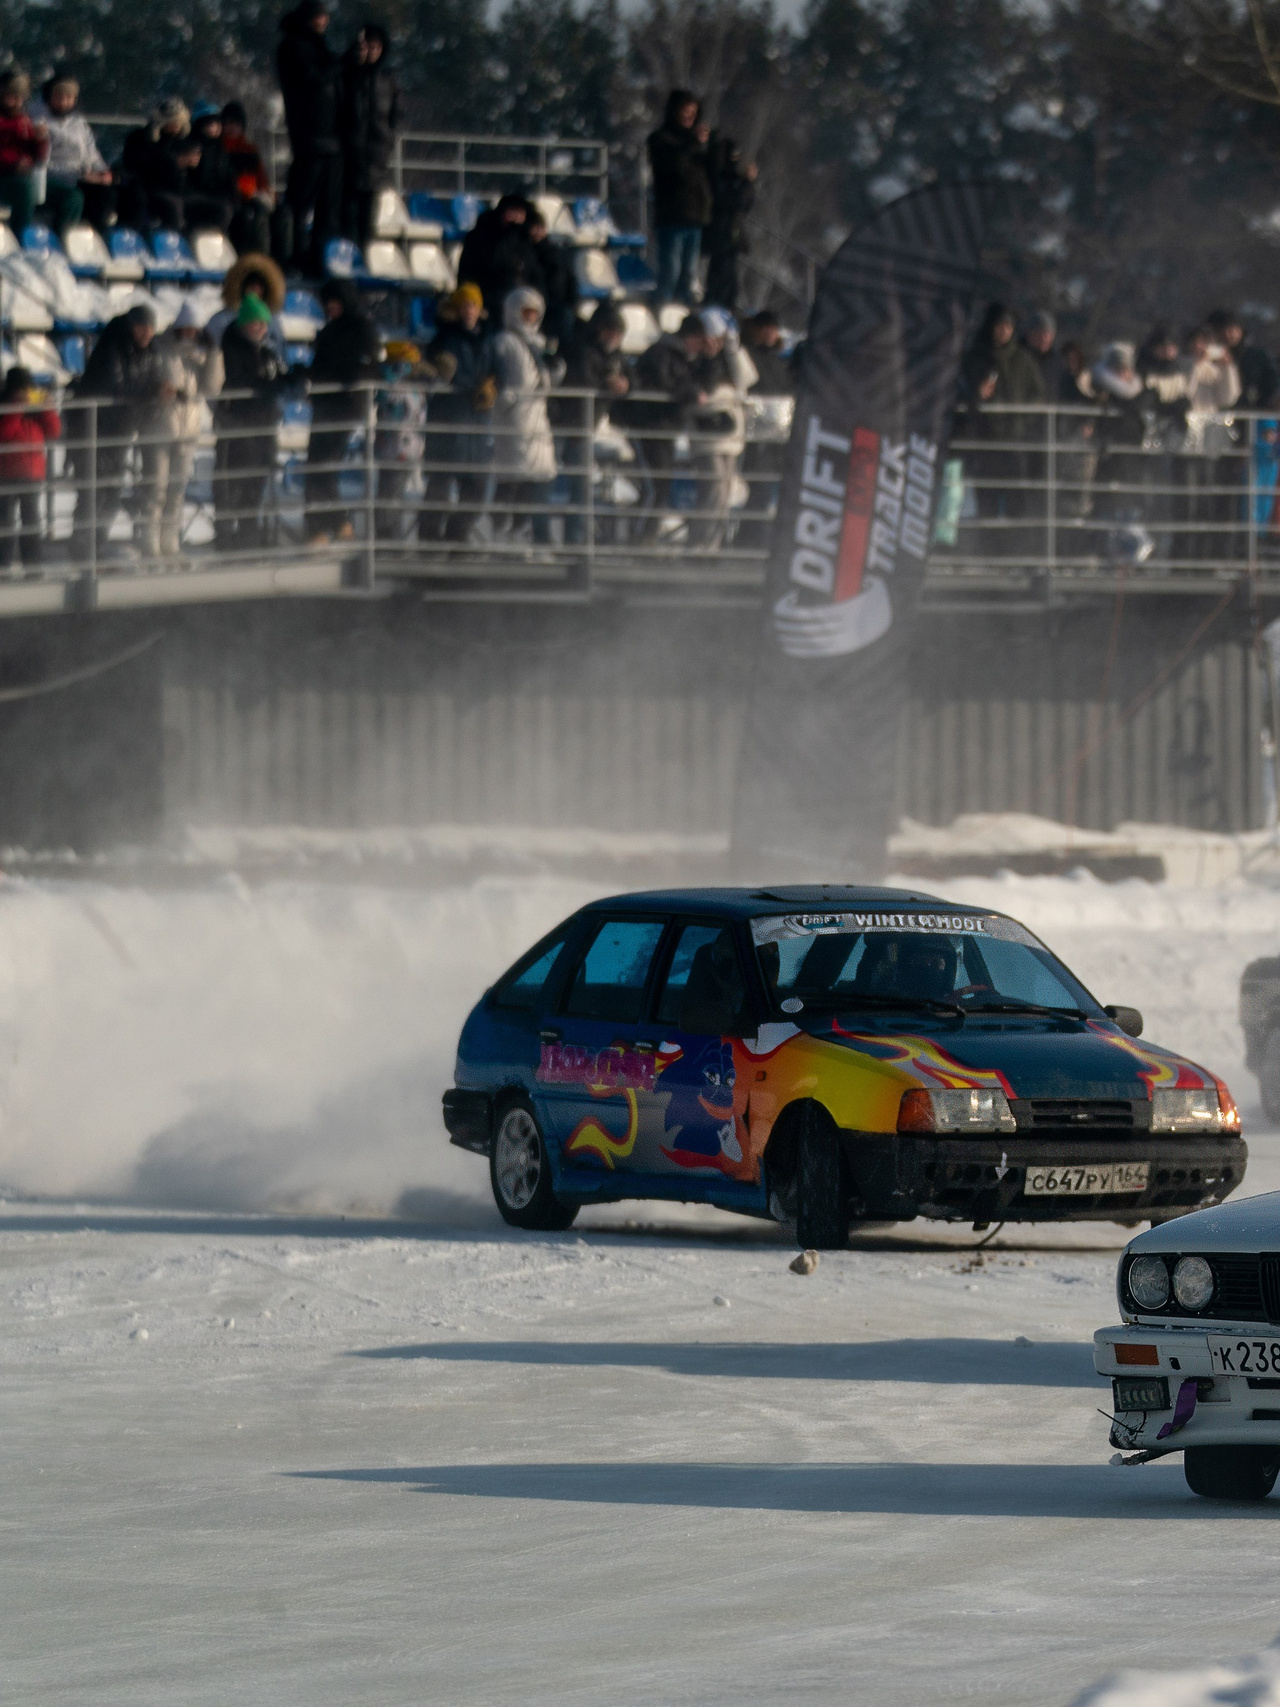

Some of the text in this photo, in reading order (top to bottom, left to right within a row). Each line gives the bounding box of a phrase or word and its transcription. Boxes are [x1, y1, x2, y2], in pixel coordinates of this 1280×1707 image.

[790, 415, 850, 593] DRIFT
[867, 437, 906, 573] TRACK
[900, 431, 937, 560] MODE
[1032, 1168, 1111, 1191] С647РУ
